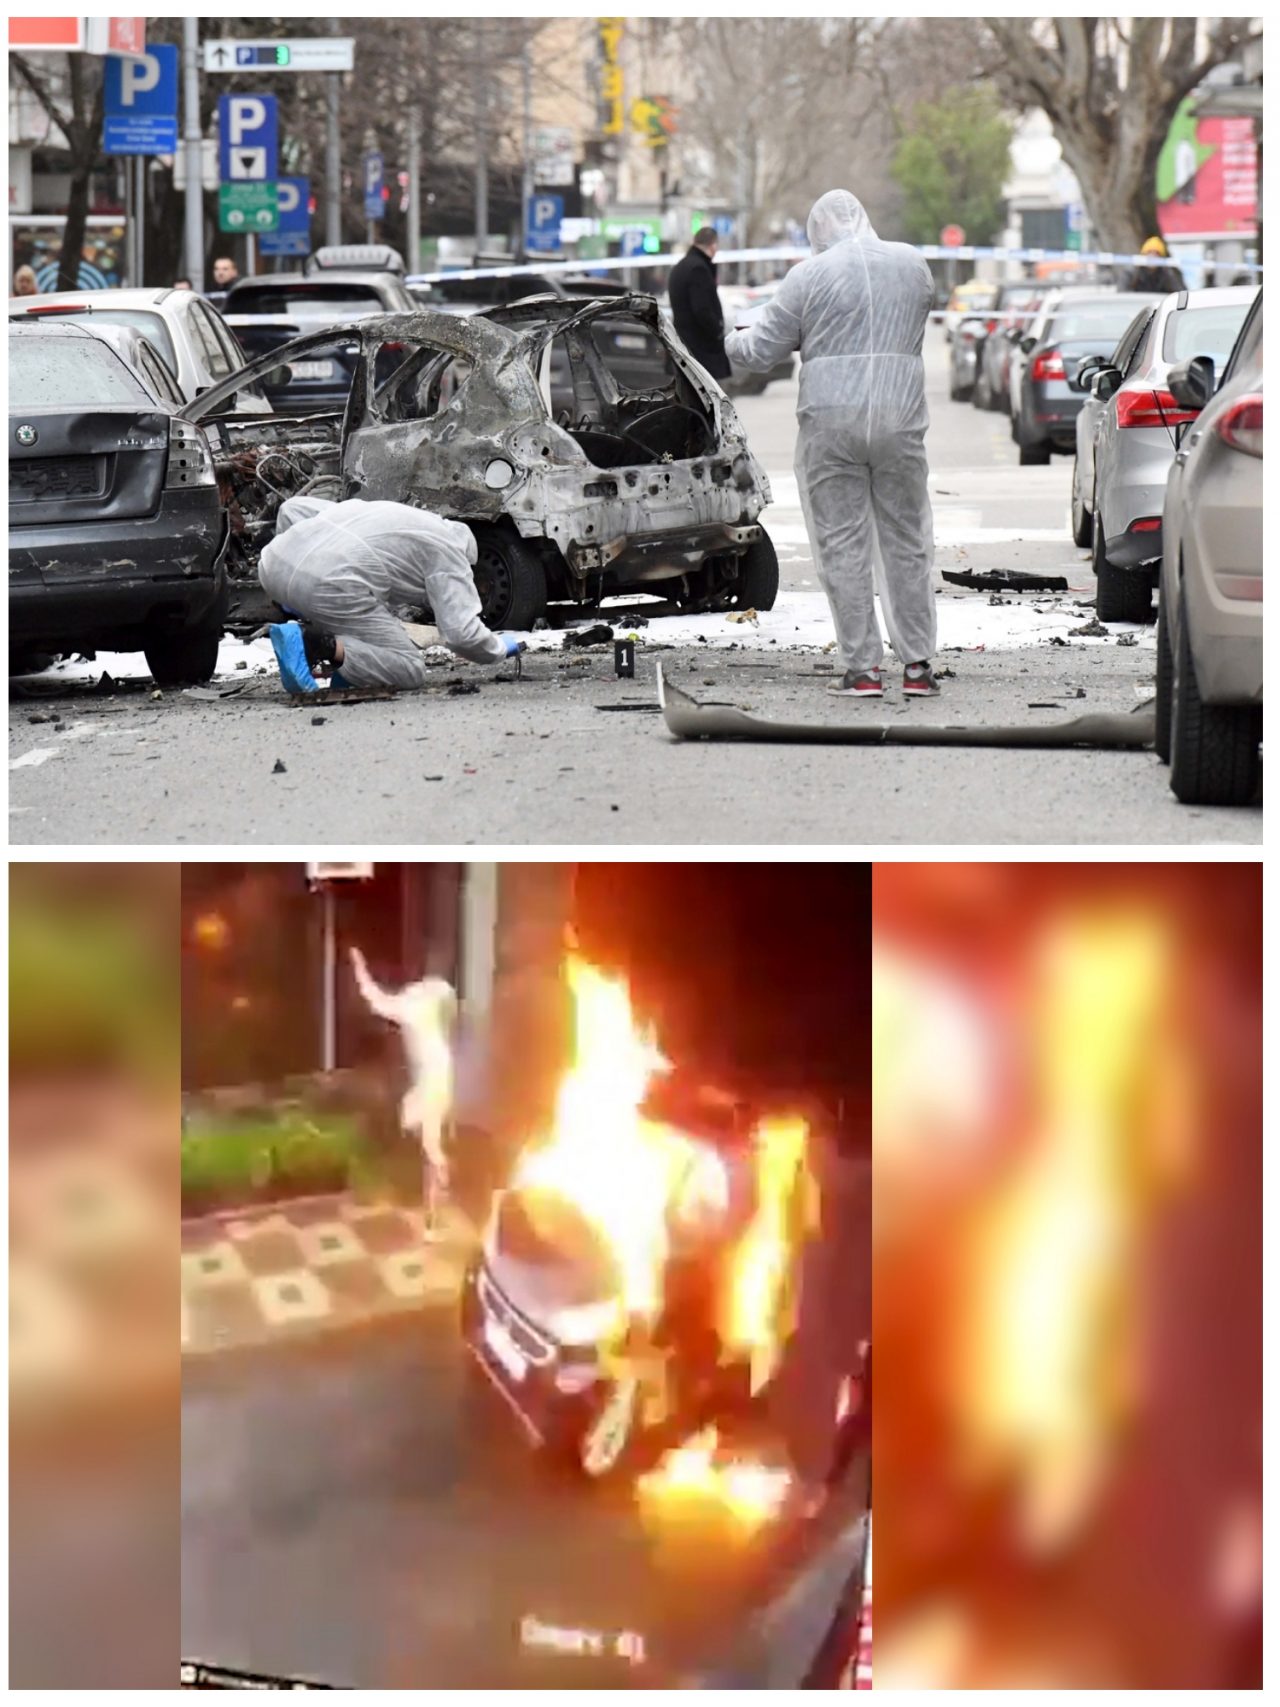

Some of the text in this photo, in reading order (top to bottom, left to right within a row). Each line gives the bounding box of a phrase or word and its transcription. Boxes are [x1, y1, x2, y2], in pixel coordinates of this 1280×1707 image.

[121, 53, 160, 106] P
[228, 98, 266, 145] P
[534, 199, 556, 229] P
[621, 648, 629, 667] 1
